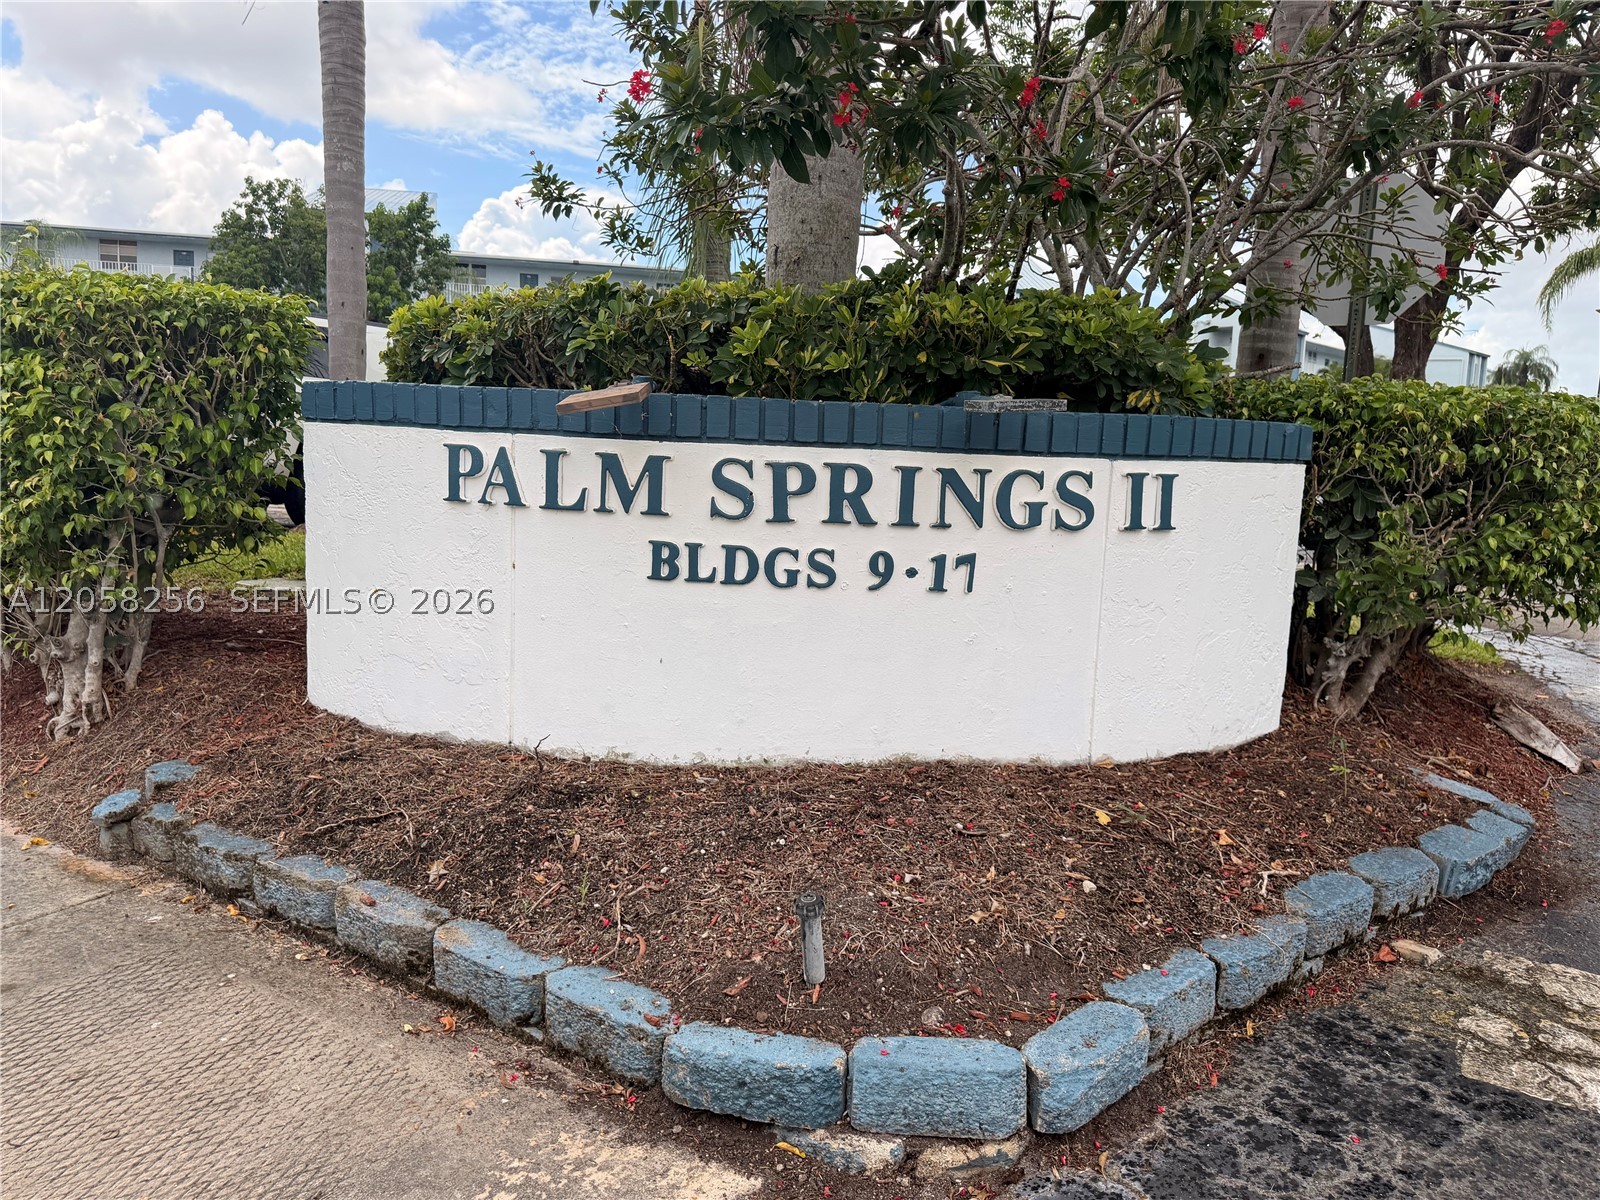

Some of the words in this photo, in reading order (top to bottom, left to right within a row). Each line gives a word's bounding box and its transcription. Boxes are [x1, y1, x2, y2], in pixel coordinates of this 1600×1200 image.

[442, 443, 673, 519] PALM
[709, 457, 1095, 534] SPRINGS
[1118, 472, 1180, 534] II
[646, 539, 837, 591] BLDGS
